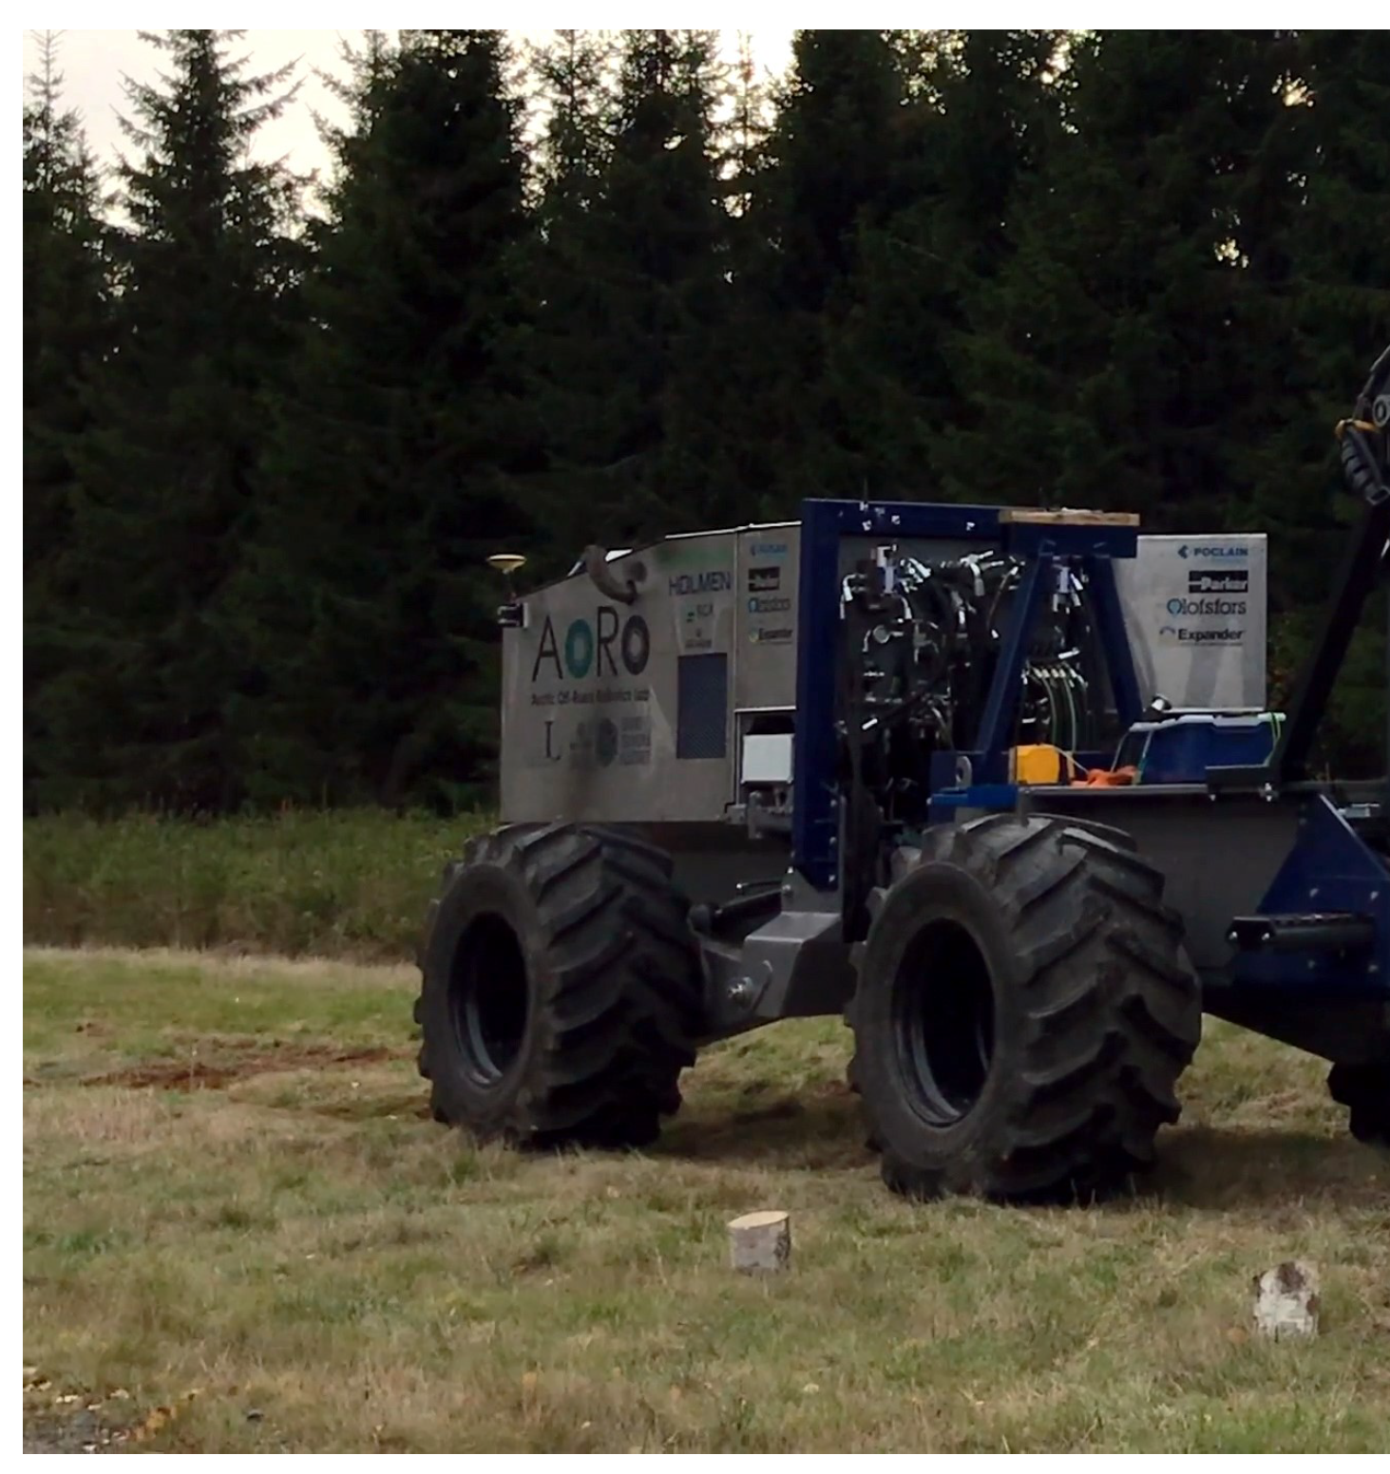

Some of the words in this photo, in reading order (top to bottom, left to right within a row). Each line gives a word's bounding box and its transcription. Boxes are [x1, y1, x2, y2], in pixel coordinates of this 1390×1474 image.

[1194, 547, 1248, 557] POCLAIN
[669, 571, 732, 597] HOLMEN
[1200, 577, 1248, 591] Parker
[1166, 598, 1247, 616] Olofsfors
[1178, 628, 1244, 642] Expander
